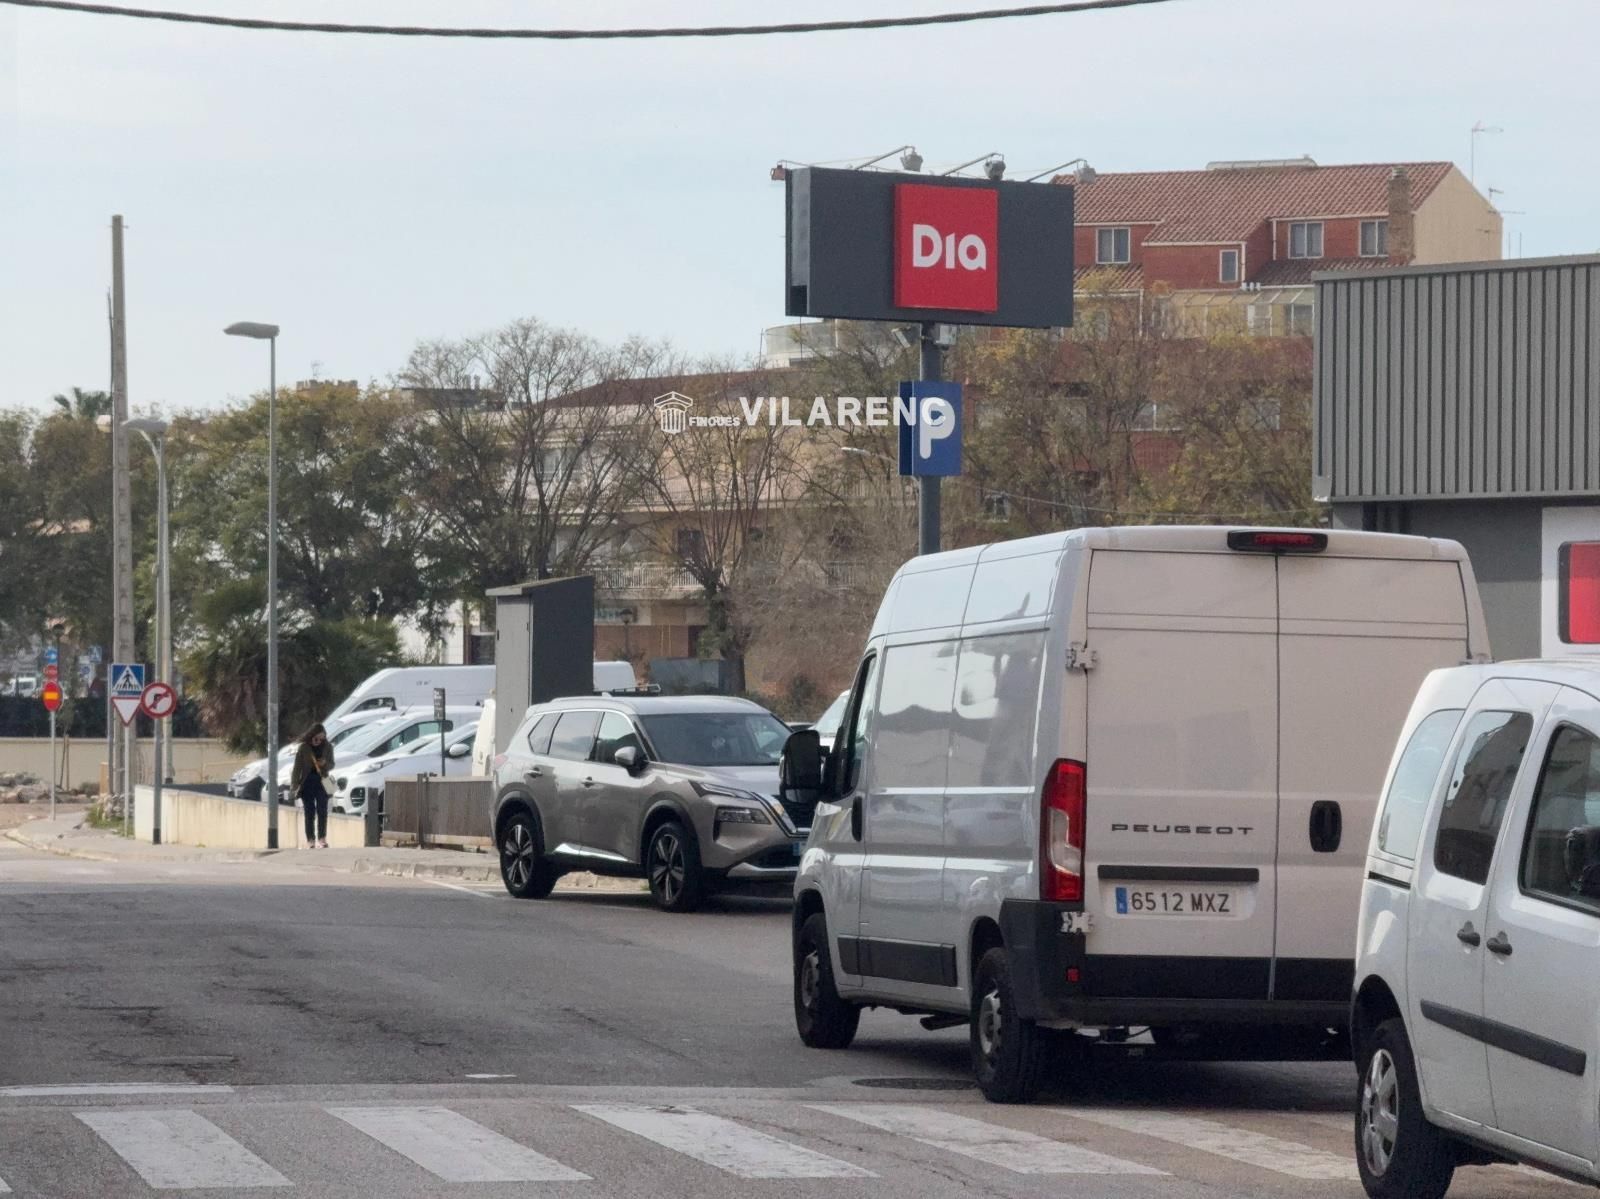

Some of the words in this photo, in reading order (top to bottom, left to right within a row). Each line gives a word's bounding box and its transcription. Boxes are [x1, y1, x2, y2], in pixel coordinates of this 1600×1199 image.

[919, 397, 956, 460] P
[1111, 823, 1254, 835] PEUGEOT
[1131, 891, 1184, 912] 6512
[1191, 892, 1231, 913] MXZ
